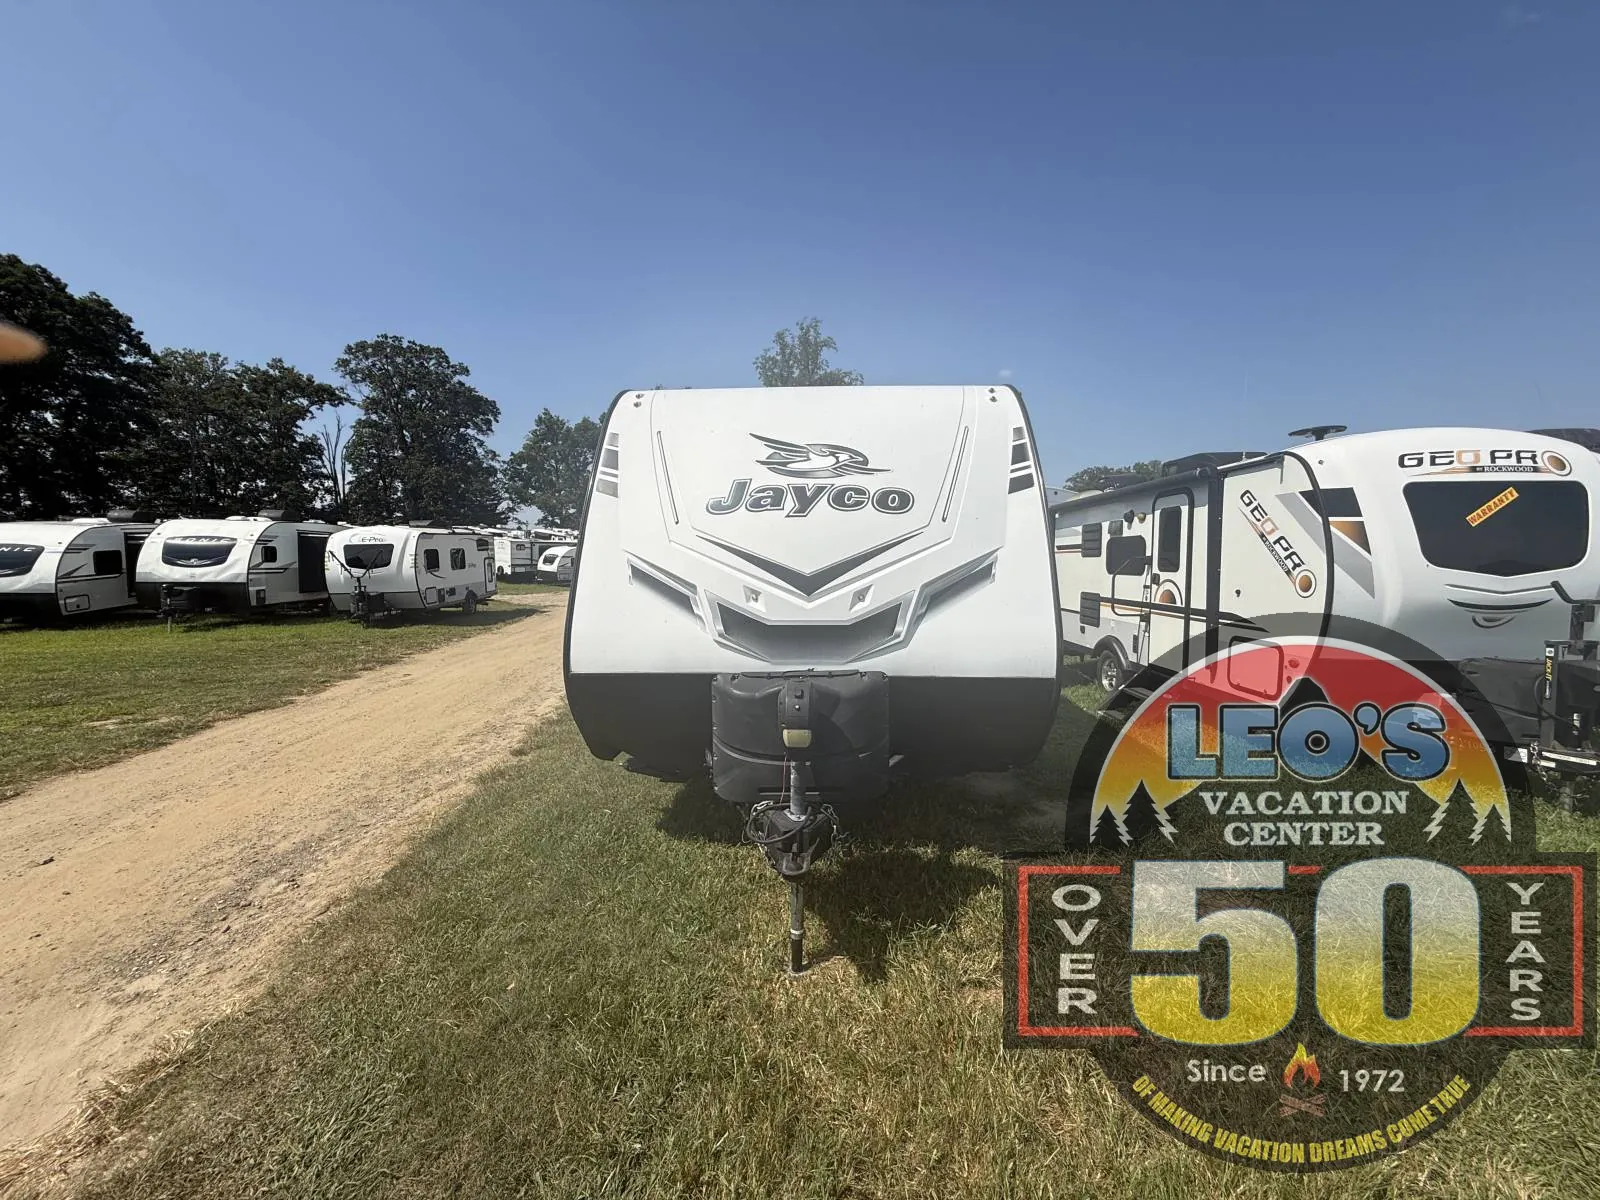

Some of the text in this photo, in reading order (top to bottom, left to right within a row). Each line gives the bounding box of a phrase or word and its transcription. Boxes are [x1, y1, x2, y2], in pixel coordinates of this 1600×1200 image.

[1397, 449, 1481, 469] GEO
[1484, 465, 1534, 473] ROCKWOOD
[705, 478, 915, 518] Jayco
[1239, 489, 1280, 536] GEO
[1467, 488, 1516, 525] WARRANTY
